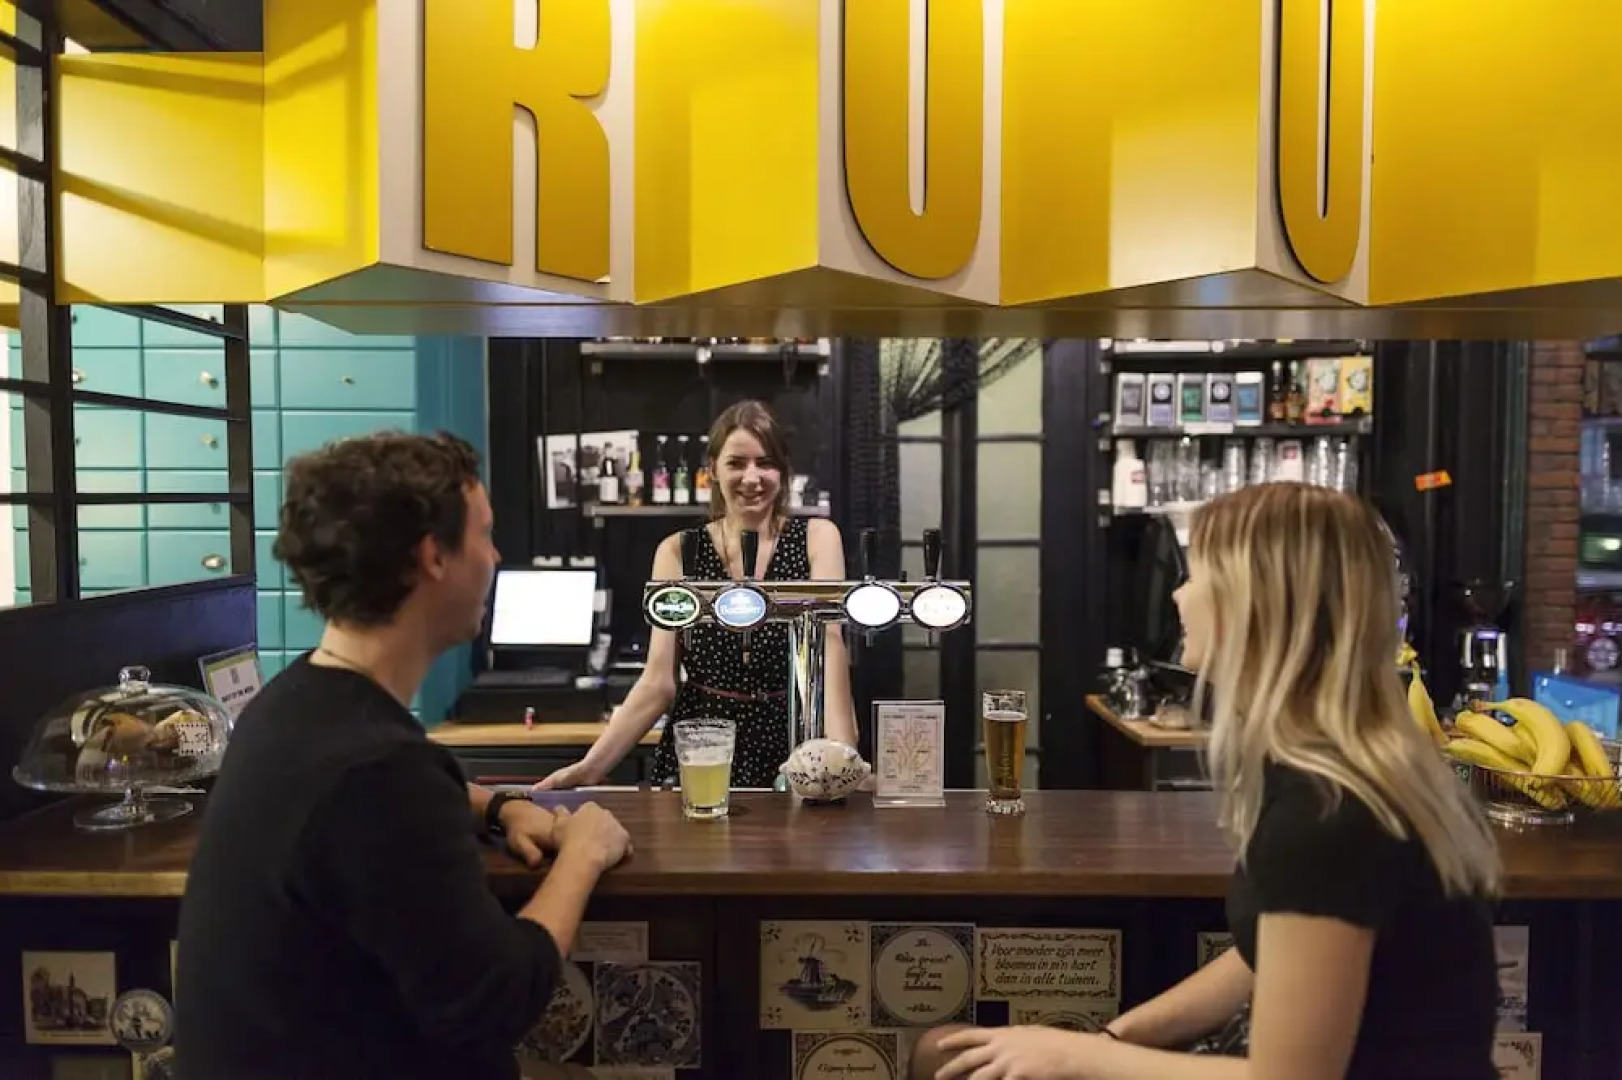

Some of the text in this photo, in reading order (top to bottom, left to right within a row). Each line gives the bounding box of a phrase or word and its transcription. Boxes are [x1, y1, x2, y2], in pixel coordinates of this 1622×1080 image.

[1071, 960, 1098, 971] hart
[995, 973, 1018, 985] dan
[1019, 973, 1032, 985] in
[1033, 973, 1056, 986] alle
